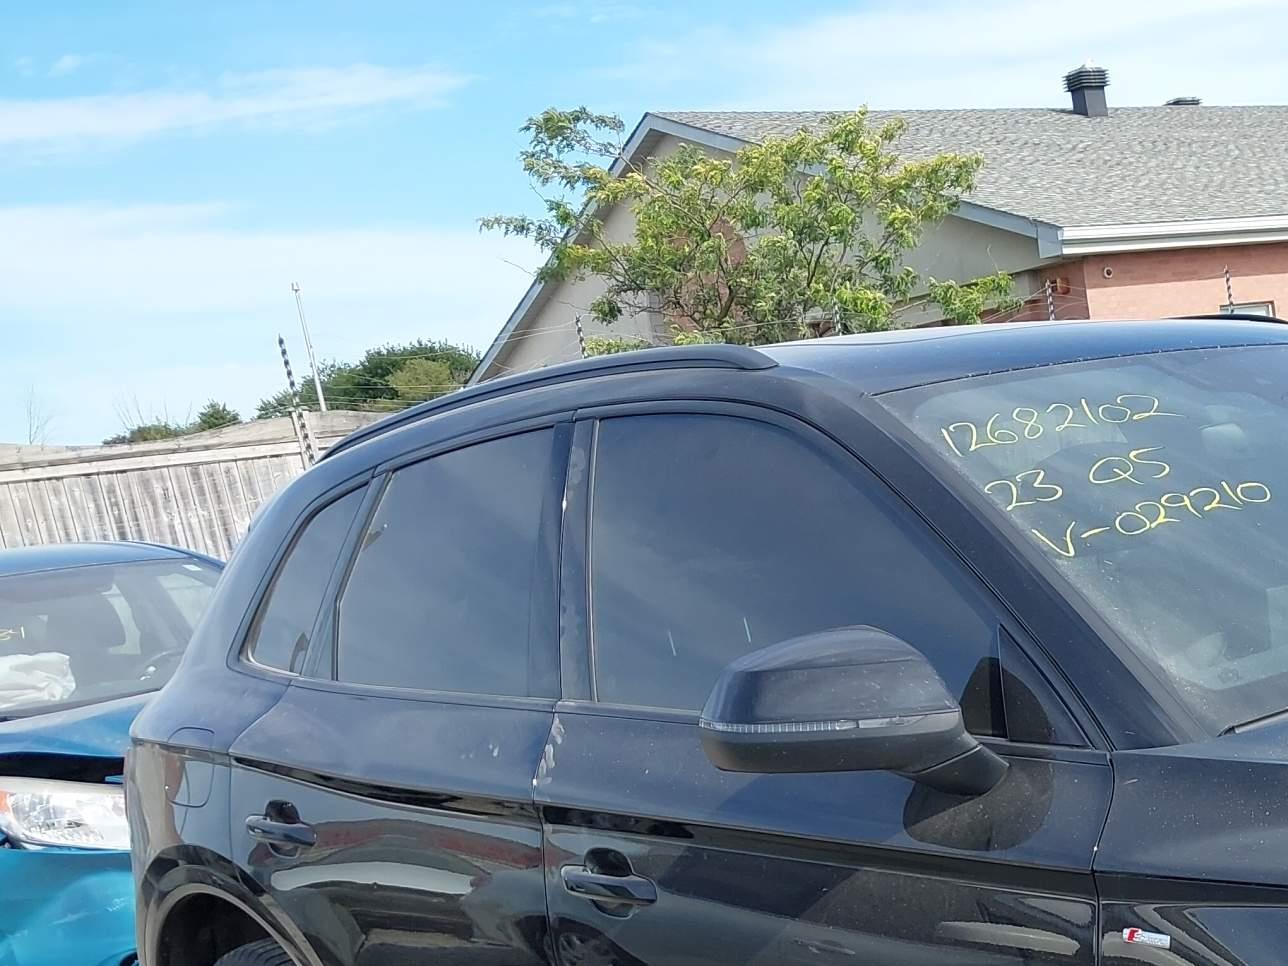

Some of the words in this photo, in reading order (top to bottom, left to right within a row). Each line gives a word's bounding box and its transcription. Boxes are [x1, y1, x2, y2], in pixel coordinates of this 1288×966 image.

[941, 394, 1183, 457] 12682102
[984, 468, 1063, 511] 23
[1088, 446, 1171, 485] Q5
[1031, 480, 1272, 557] V-029210
